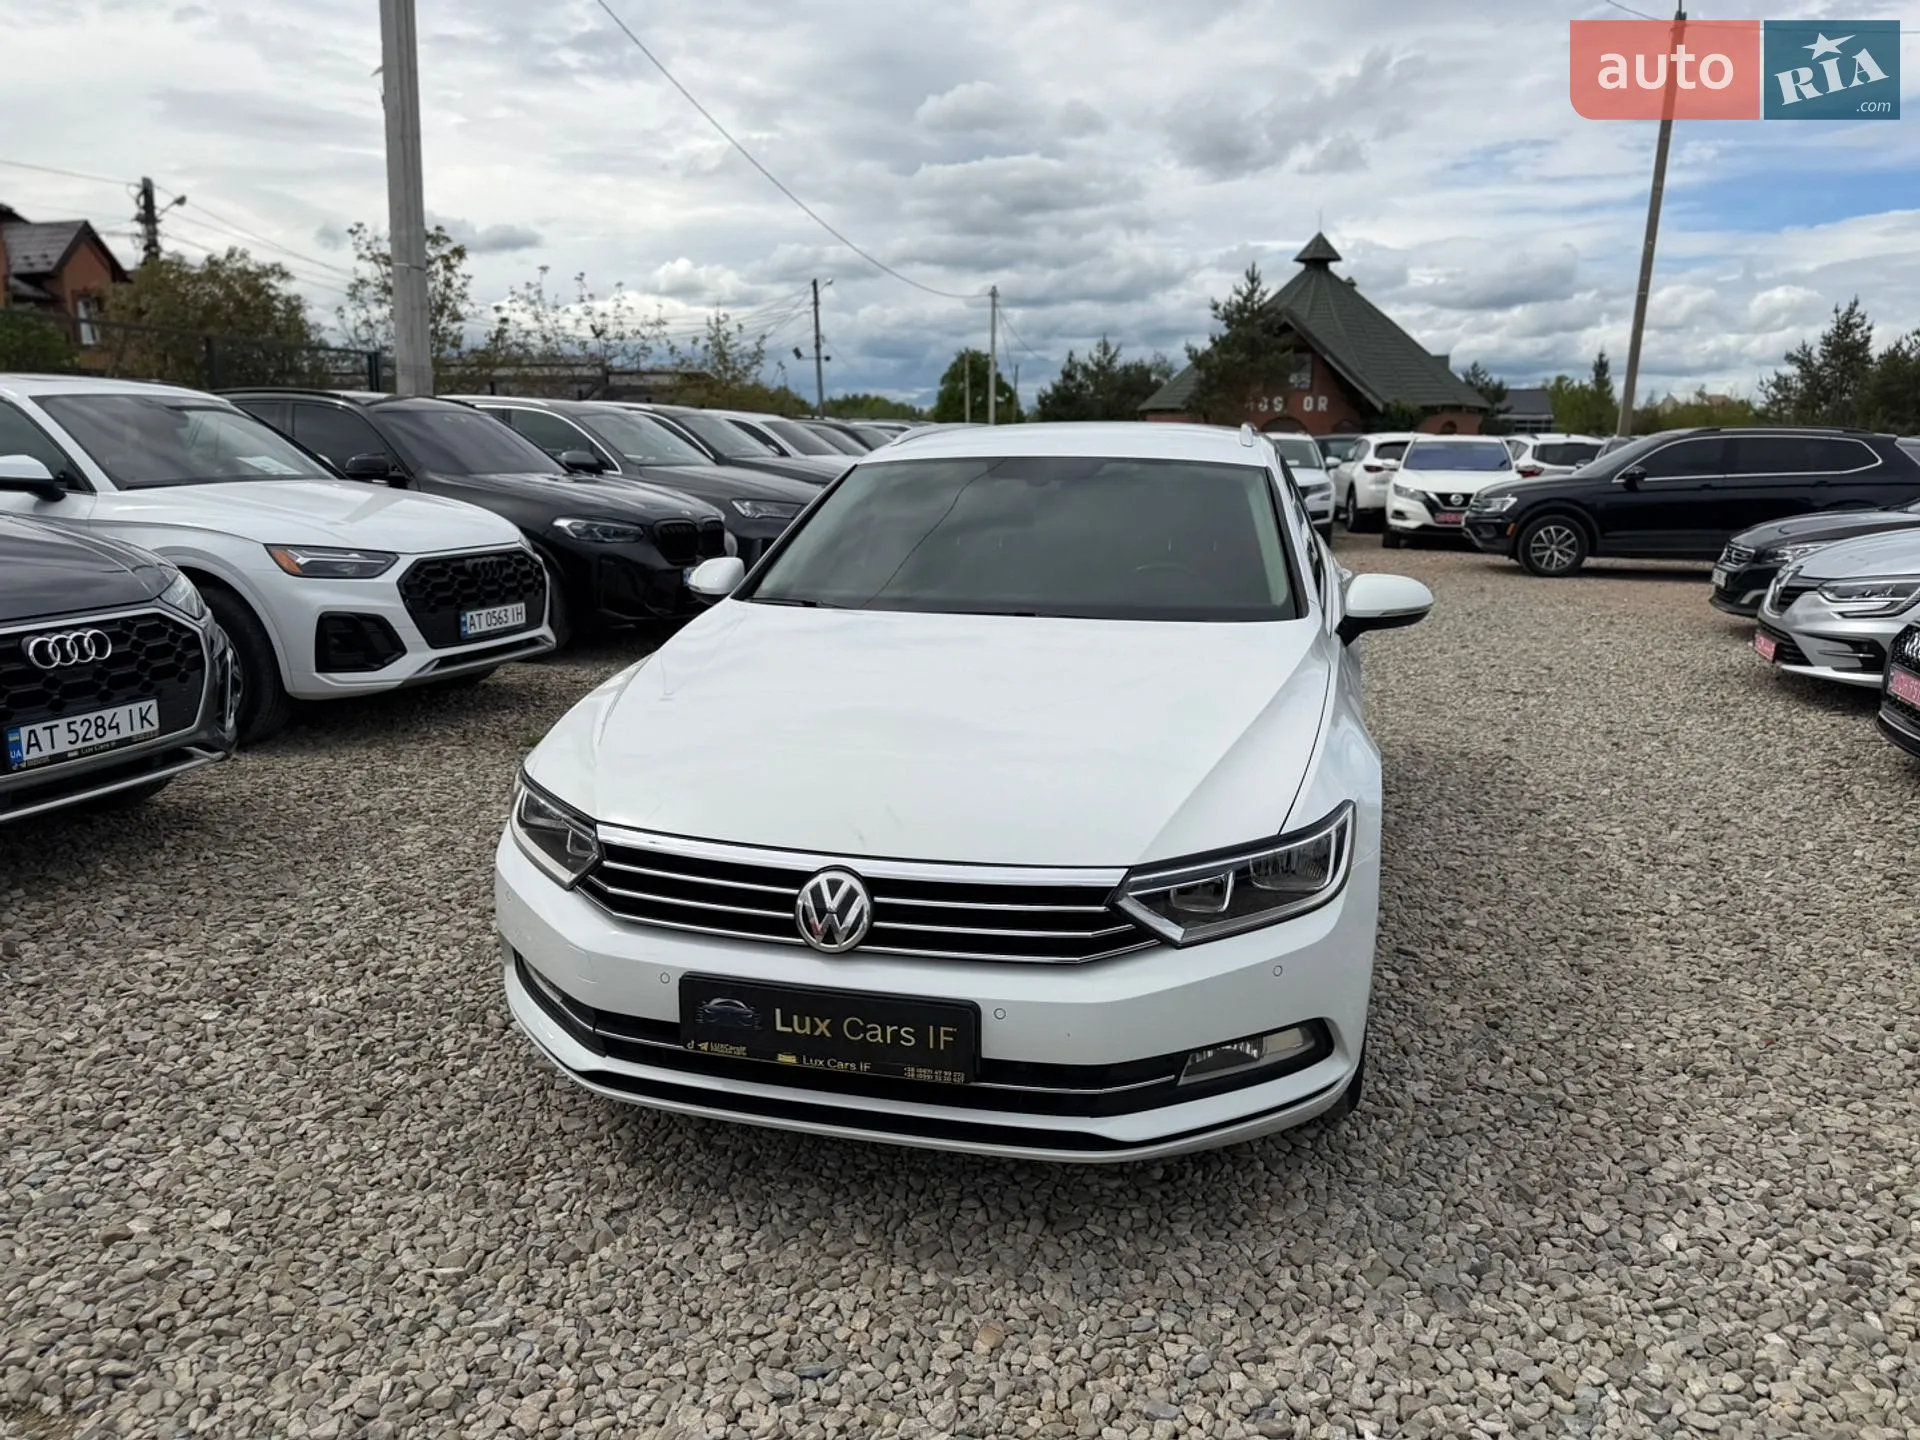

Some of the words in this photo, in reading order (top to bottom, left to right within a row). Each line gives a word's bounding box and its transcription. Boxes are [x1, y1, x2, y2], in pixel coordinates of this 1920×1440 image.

[469, 613, 483, 631] AT
[486, 608, 509, 627] 0563
[26, 725, 59, 755] AT
[67, 711, 121, 745] 5284
[129, 704, 155, 732] IK
[10, 751, 22, 759] UA
[775, 1008, 832, 1038] Lux
[843, 1017, 916, 1047] Cars
[929, 1025, 957, 1050] IF
[802, 1055, 825, 1067] Lux
[827, 1058, 857, 1071] Cars
[860, 1062, 872, 1072] IF
